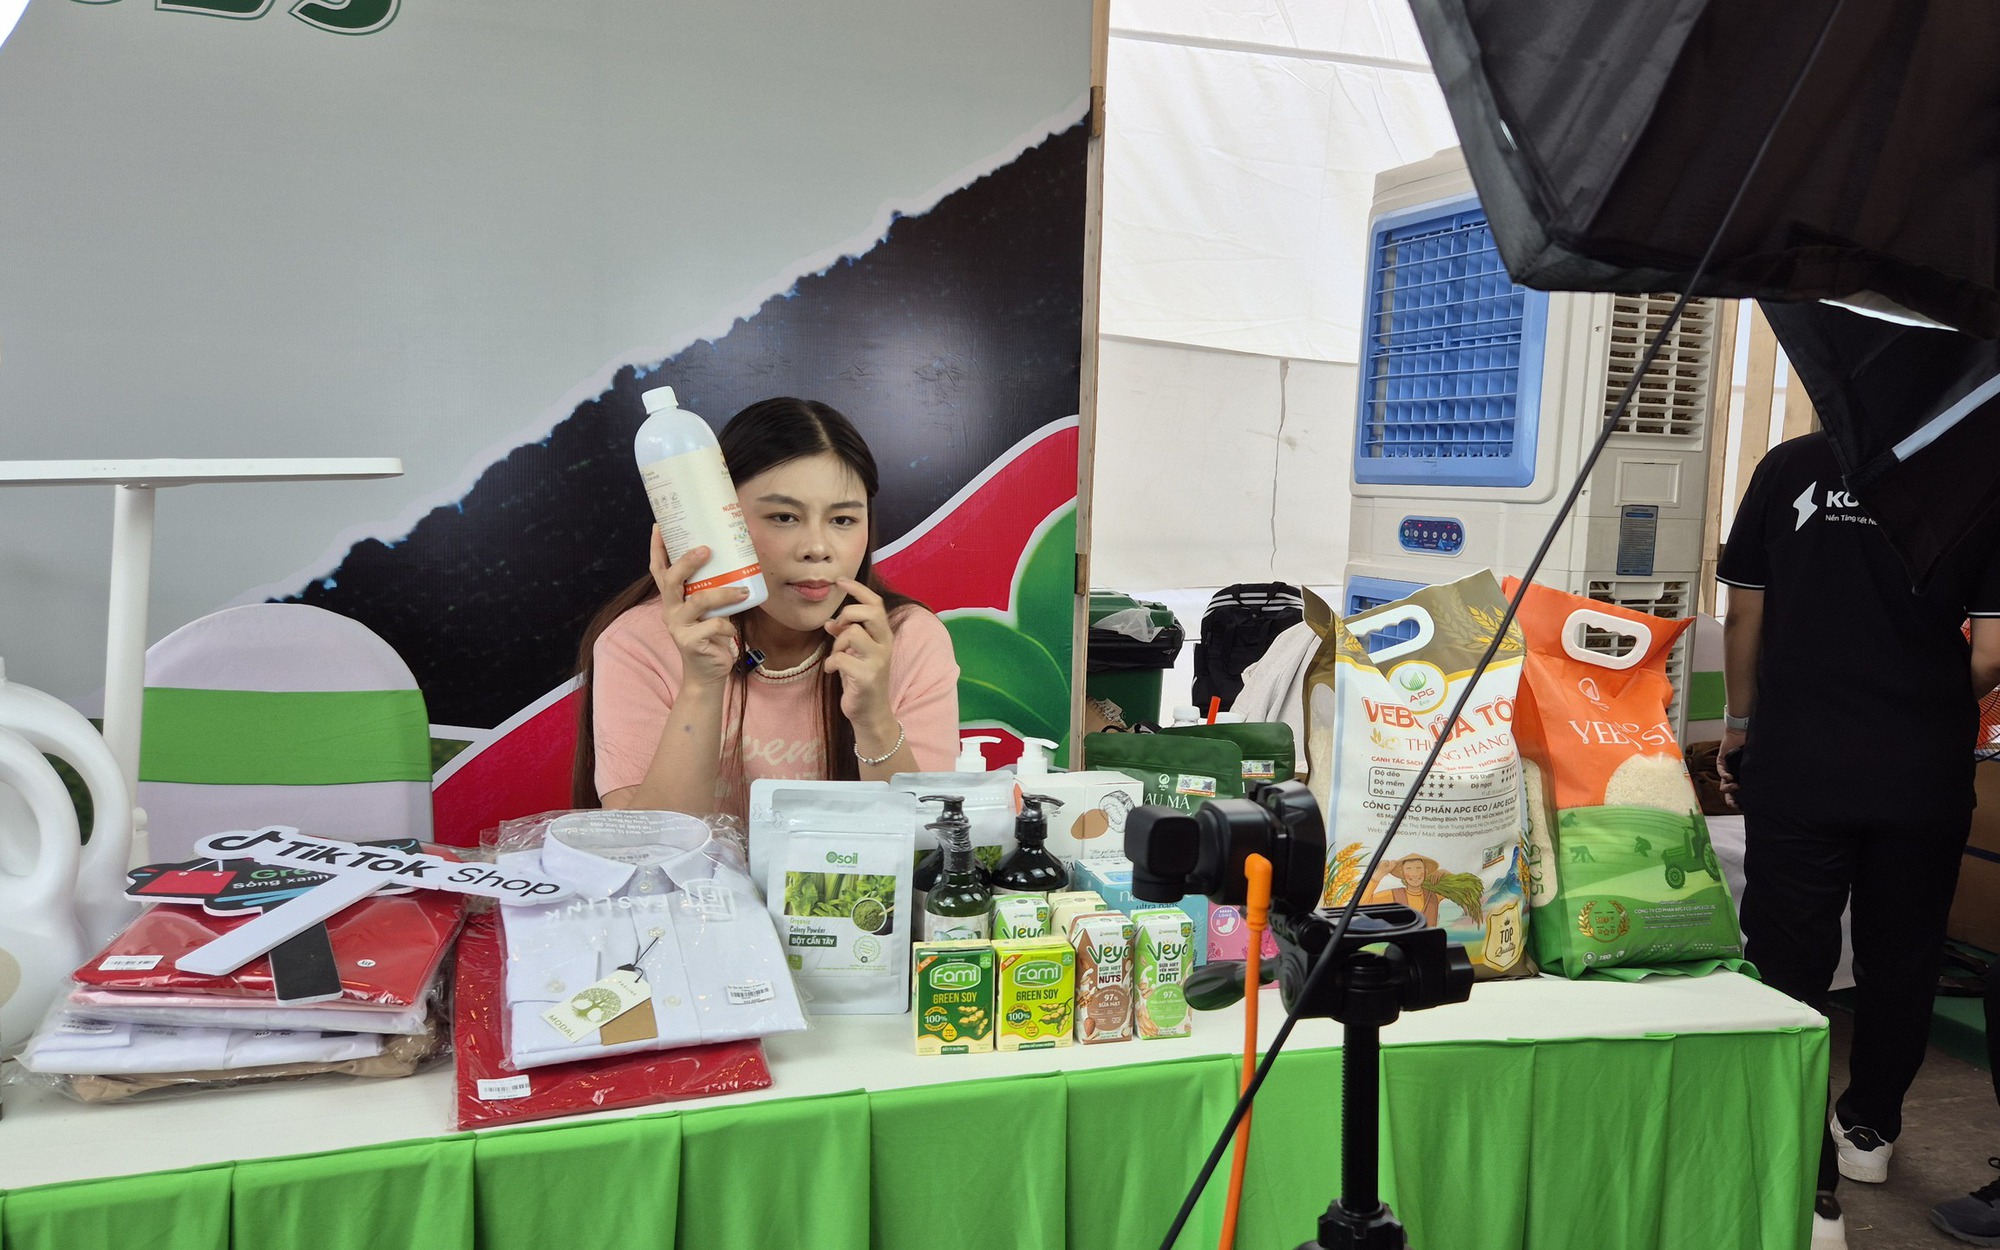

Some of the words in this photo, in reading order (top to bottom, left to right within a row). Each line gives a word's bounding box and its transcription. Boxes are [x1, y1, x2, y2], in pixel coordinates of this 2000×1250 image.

[1826, 490, 1860, 508] KO
[1410, 688, 1434, 702] APG
[1474, 695, 1516, 727] TÔ
[1144, 792, 1164, 806] AU
[1166, 794, 1190, 810] MÁ
[1362, 800, 1390, 810] CÔNG
[1424, 805, 1452, 814] PHẦN
[1454, 806, 1471, 814] APG
[1473, 804, 1488, 812] ECO
[276, 840, 440, 878] TikTok
[448, 868, 560, 897] Shop
[286, 873, 329, 884] xanh
[791, 937, 805, 946] BỘT
[1500, 927, 1513, 944] TOP
[1099, 975, 1121, 984] NUTS
[1159, 973, 1178, 982] OAT
[933, 993, 959, 1004] GREEN
[961, 992, 977, 1002] SOY
[1016, 991, 1041, 1001] GREEN
[1043, 989, 1058, 999] SOY
[925, 1015, 948, 1023] 100%
[1008, 1012, 1030, 1020] 100%
[548, 1014, 575, 1037] MODAL
